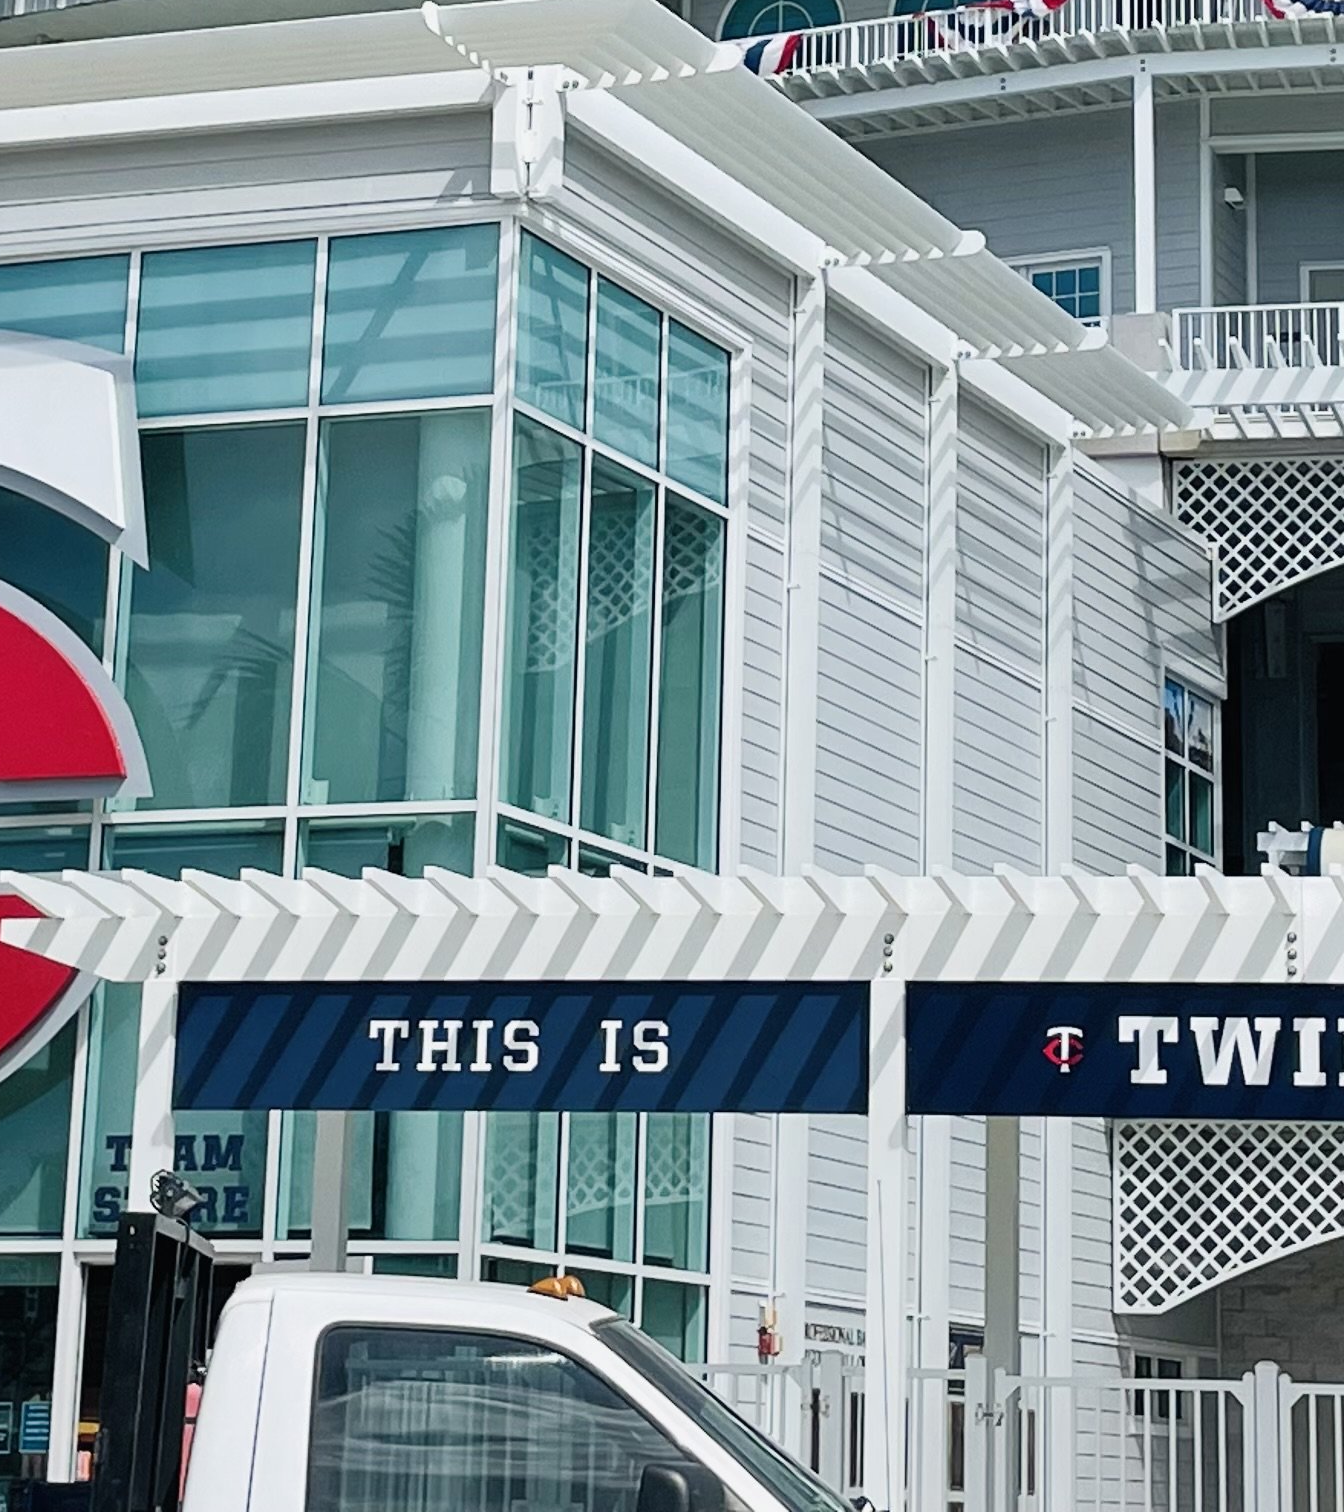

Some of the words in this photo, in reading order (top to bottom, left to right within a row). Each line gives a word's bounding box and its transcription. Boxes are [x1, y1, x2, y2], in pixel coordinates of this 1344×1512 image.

[368, 1019, 540, 1072] THIS
[598, 1019, 670, 1072] IS
[106, 1134, 246, 1172] TAM
[92, 1185, 250, 1223] SRE
